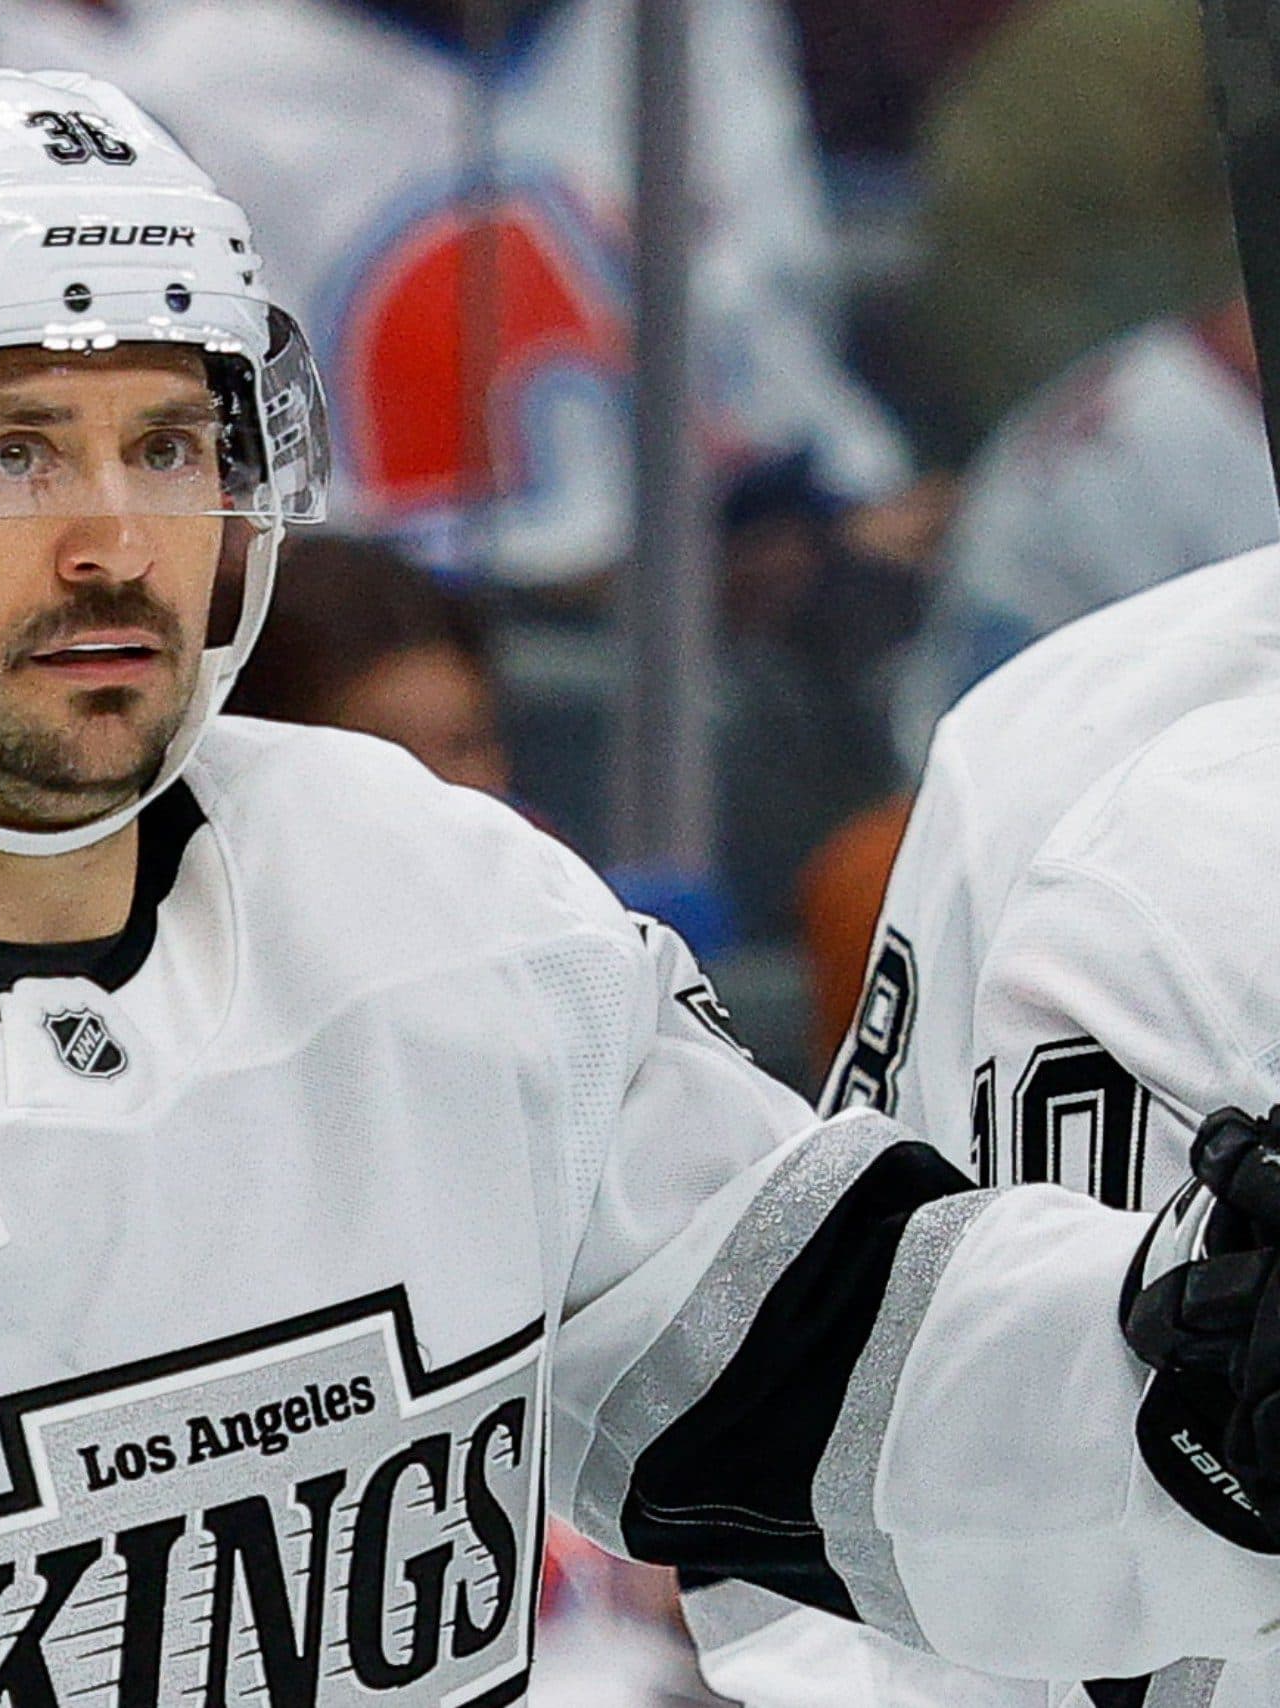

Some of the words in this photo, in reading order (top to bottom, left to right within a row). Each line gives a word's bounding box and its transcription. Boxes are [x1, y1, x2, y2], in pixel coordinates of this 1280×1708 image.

[25, 110, 137, 166] 36
[41, 225, 196, 247] BAUER
[71, 1022, 103, 1069] NHL
[78, 1431, 177, 1492] Los
[186, 1375, 376, 1466] Angeles
[1171, 1429, 1261, 1517] AUER
